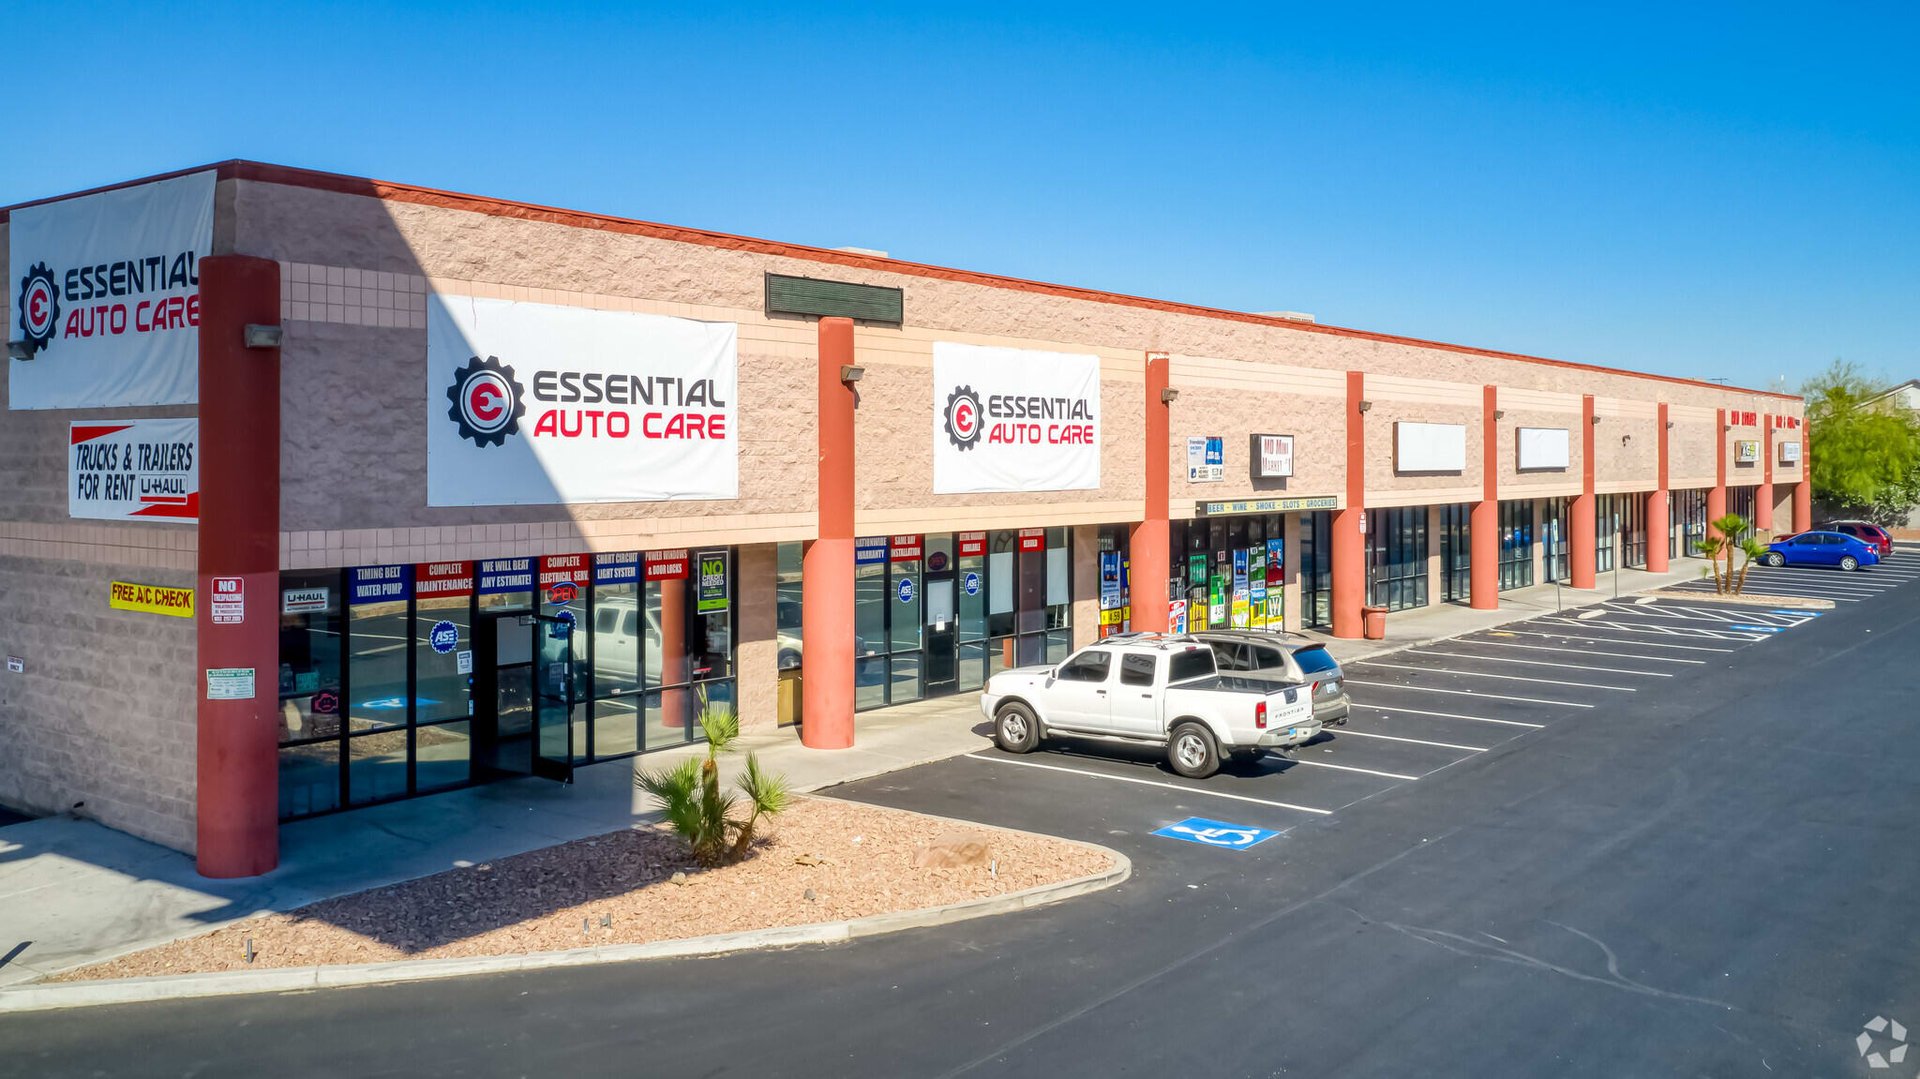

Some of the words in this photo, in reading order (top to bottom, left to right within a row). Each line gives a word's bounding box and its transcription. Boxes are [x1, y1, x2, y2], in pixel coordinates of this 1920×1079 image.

[65, 251, 199, 301] ESSENTIAL
[64, 304, 127, 339] AUTO
[136, 296, 199, 332] CARE
[533, 370, 726, 408] ESSENTIAL
[988, 395, 1094, 420] ESSENTIAL
[533, 409, 630, 438] AUTO
[642, 412, 726, 439] CARE
[988, 423, 1042, 444] AUTO
[1048, 424, 1094, 444] CARE
[76, 443, 118, 471] TRUCKS
[123, 445, 132, 471] &
[138, 443, 193, 471] TRAILERS
[78, 474, 99, 500] FOR
[105, 474, 135, 500] RENT
[1208, 503, 1225, 513] BEER
[1232, 502, 1247, 511] WINE
[1256, 501, 1276, 510] SMOKE
[1282, 500, 1300, 509] SLOTS
[1306, 498, 1336, 507] GROCERIES
[596, 554, 615, 565] SHORT
[616, 552, 638, 563] CIRCUIT
[645, 551, 662, 561] POWER
[663, 549, 688, 560] WINDOWS
[857, 549, 885, 560] WARRANTY
[890, 547, 920, 557] INSTALLATION
[482, 561, 494, 573] WE
[495, 560, 511, 572] WILL
[512, 559, 530, 570] BEAT
[547, 556, 580, 568] COMPLETE
[648, 566, 653, 575] &
[653, 565, 667, 575] DOOR
[667, 563, 682, 574] LOCKS
[702, 560, 724, 576] NO
[357, 568, 384, 581] TIMING
[384, 566, 401, 579] BELT
[429, 563, 463, 576] COMPLETE
[597, 568, 614, 579] LIGHT
[614, 567, 636, 578] SYSTEM
[481, 576, 496, 588] ANY
[540, 571, 572, 584] ELECTRICAL
[218, 580, 237, 592] NO
[357, 584, 381, 597] WATER
[382, 582, 403, 595] PUMP
[416, 578, 473, 593] MAINTENANCE
[112, 583, 134, 602] FREE
[135, 588, 153, 604] A/C
[154, 589, 192, 608] CHECK
[287, 593, 325, 602] U-HAUL
[547, 587, 579, 601] OPEN
[435, 630, 454, 642] ASE
